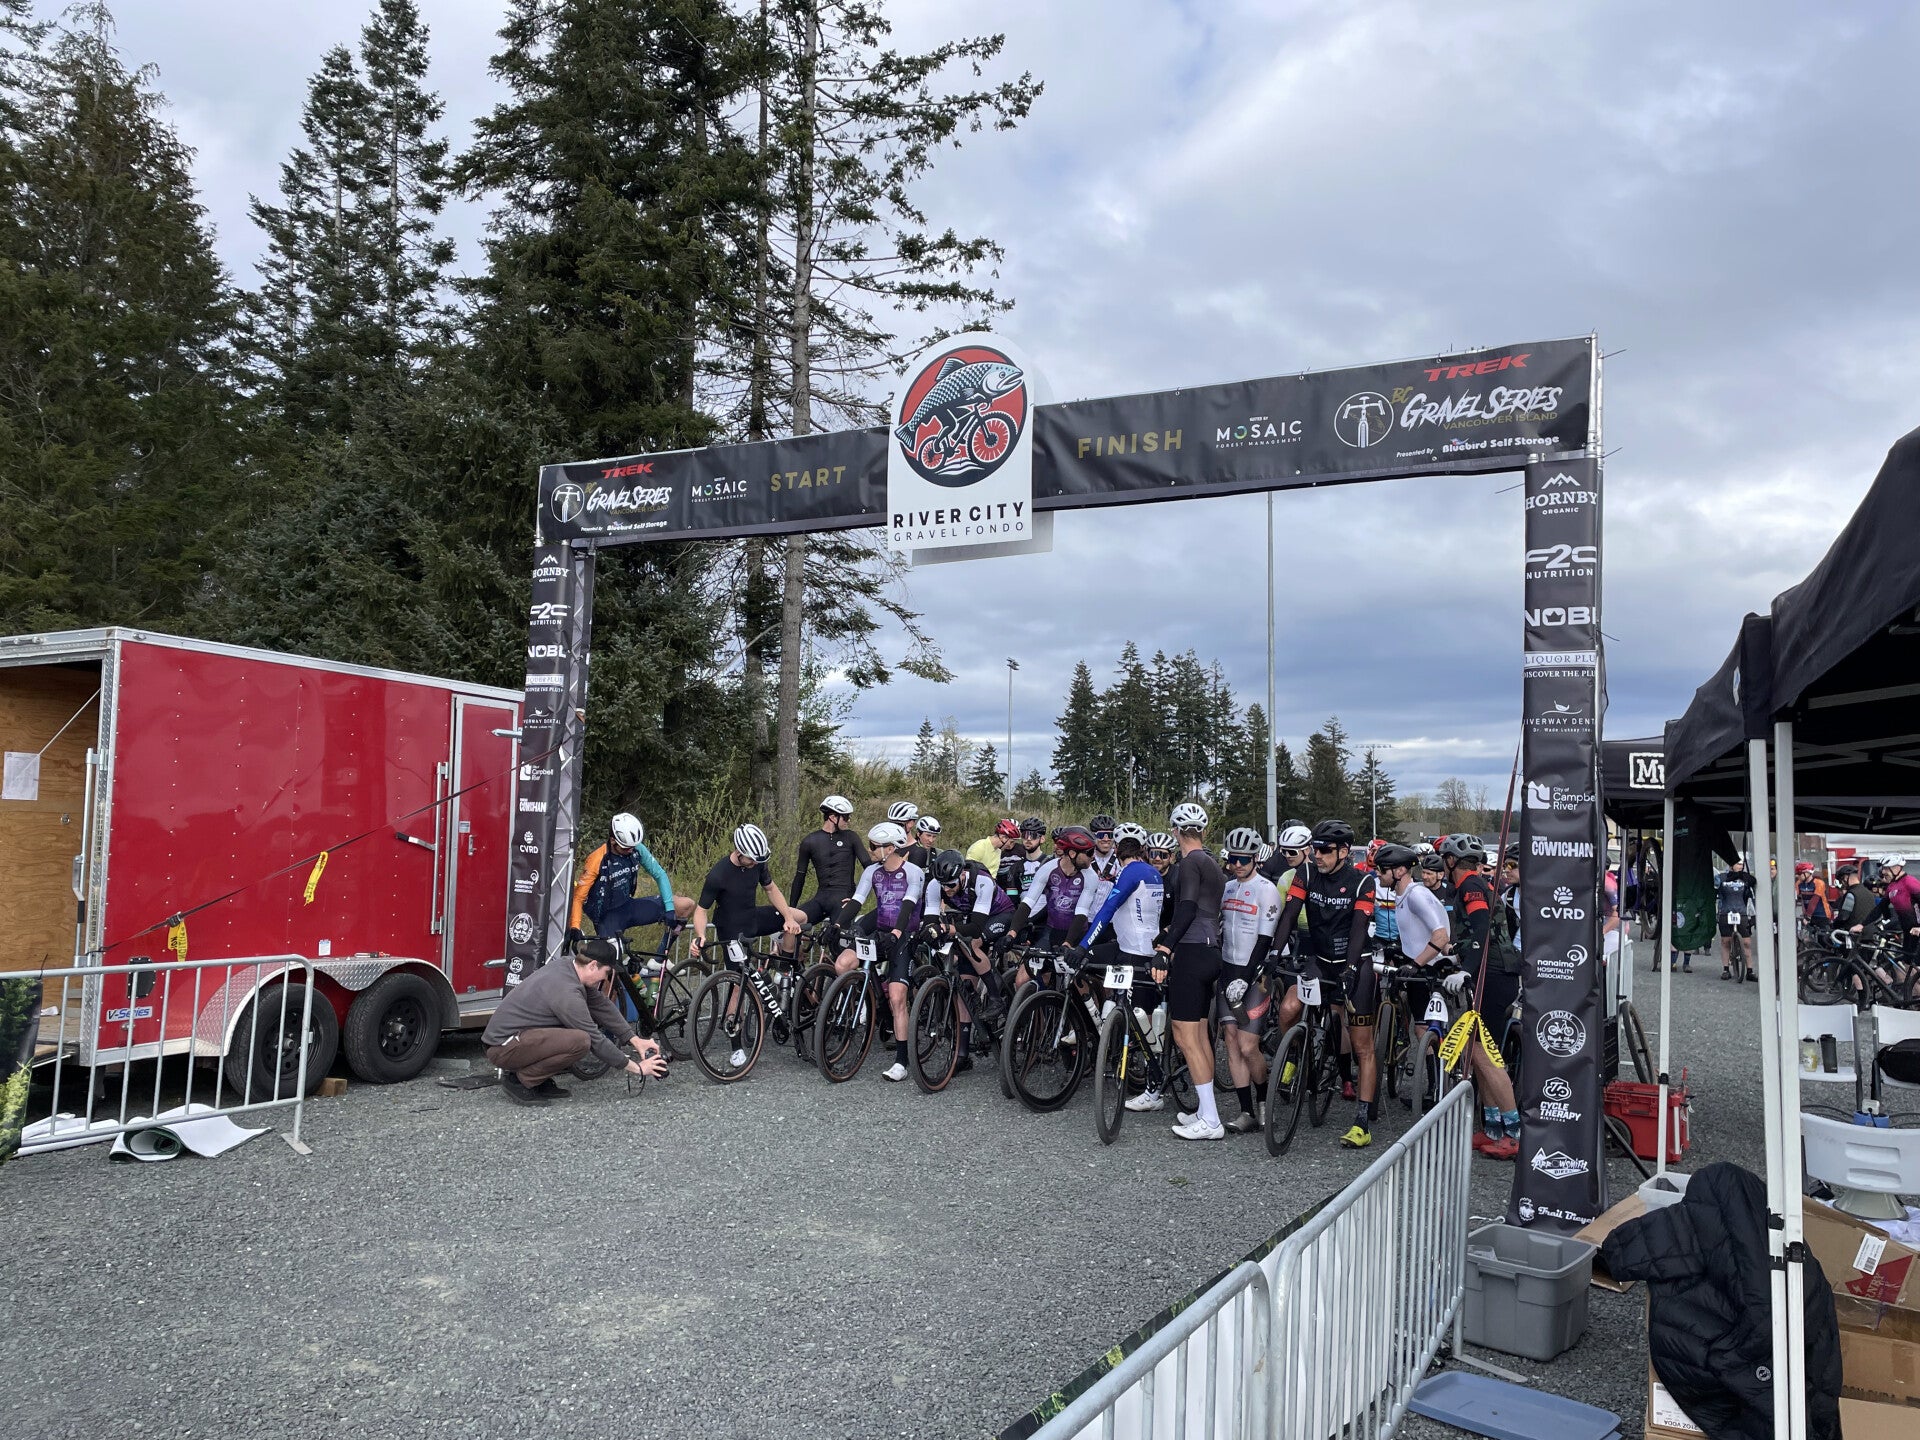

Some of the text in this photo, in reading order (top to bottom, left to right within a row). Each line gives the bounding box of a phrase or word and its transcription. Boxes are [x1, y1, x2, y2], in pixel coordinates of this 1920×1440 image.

[1424, 353, 1531, 382] TREK
[1392, 386, 1414, 404] BC
[1443, 412, 1558, 431] VANCOUVER ISLAND
[1216, 420, 1302, 442] MOSAIC
[1077, 428, 1183, 459] FINISH
[1248, 436, 1302, 446] MANAGEMENT
[1442, 435, 1560, 453] Bluebird Self Storage
[1396, 449, 1424, 458] Presented
[601, 462, 655, 479] TREK
[770, 465, 847, 493] START
[691, 480, 747, 498] MOSAIC
[1525, 490, 1598, 510] HORNBY
[893, 501, 1024, 528] RIVER CITY
[1542, 507, 1579, 515] ORGANIC
[893, 521, 1024, 542] GRAVEL FONDO
[532, 567, 570, 579] HORNBY
[1526, 568, 1594, 580] NUTRITION
[1525, 653, 1595, 665] LIQUOR PLU
[1553, 792, 1596, 803] Campbe
[1553, 801, 1578, 810] River
[519, 844, 539, 854] CVRD
[1532, 841, 1594, 858] COWICHAN
[1540, 906, 1585, 920] CVRD
[861, 944, 870, 956] 19
[1537, 959, 1575, 968] nanaimo
[1537, 967, 1575, 975] HOSPITALITY
[1537, 972, 1574, 981] ASSOCIATION
[1113, 974, 1124, 984] 10
[750, 971, 783, 1018] FACTOR
[1302, 987, 1312, 999] 17
[1429, 1000, 1442, 1012] 30
[108, 1007, 150, 1020] V-Seies
[1550, 1010, 1573, 1020] PEDAL
[1540, 1101, 1569, 1111] CYCLE
[1540, 1108, 1582, 1122] THERAPY
[1538, 1206, 1563, 1219] Trail
[1564, 1210, 1596, 1225] Bicycl
